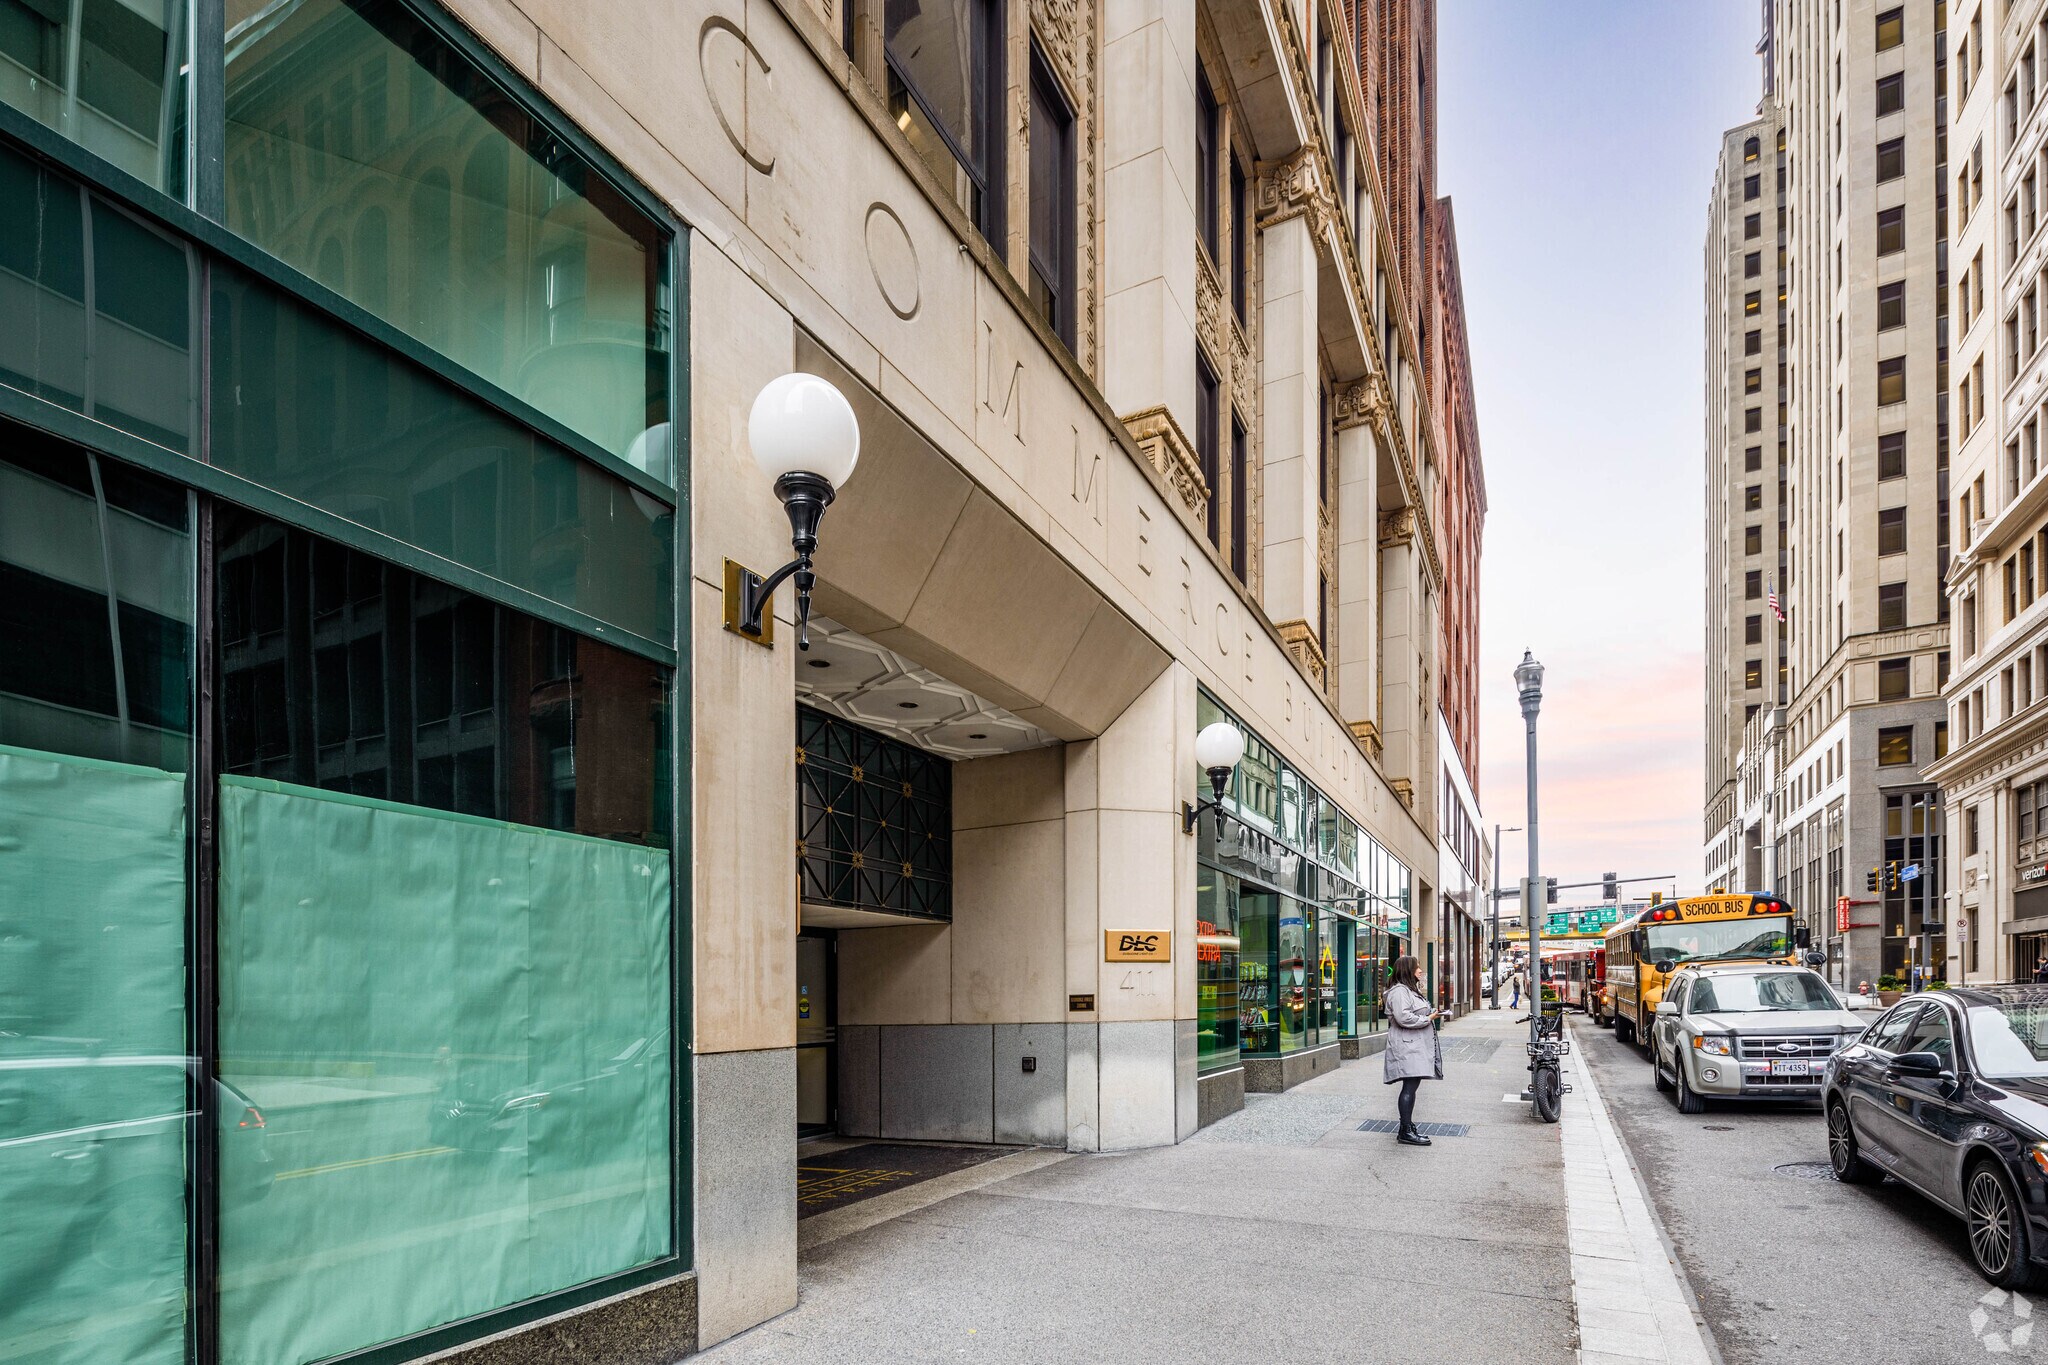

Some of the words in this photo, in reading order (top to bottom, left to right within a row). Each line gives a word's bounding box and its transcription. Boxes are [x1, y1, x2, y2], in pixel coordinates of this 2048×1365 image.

[698, 15, 1253, 682] COMMERCE
[1285, 681, 1378, 813] BUILDING
[2021, 865, 2046, 881] verizon
[1686, 902, 1722, 916] SCHOOL
[1725, 900, 1743, 913] BUS
[1119, 935, 1159, 952] DLC
[1197, 943, 1221, 962] EXTRA
[1120, 970, 1156, 997] 411
